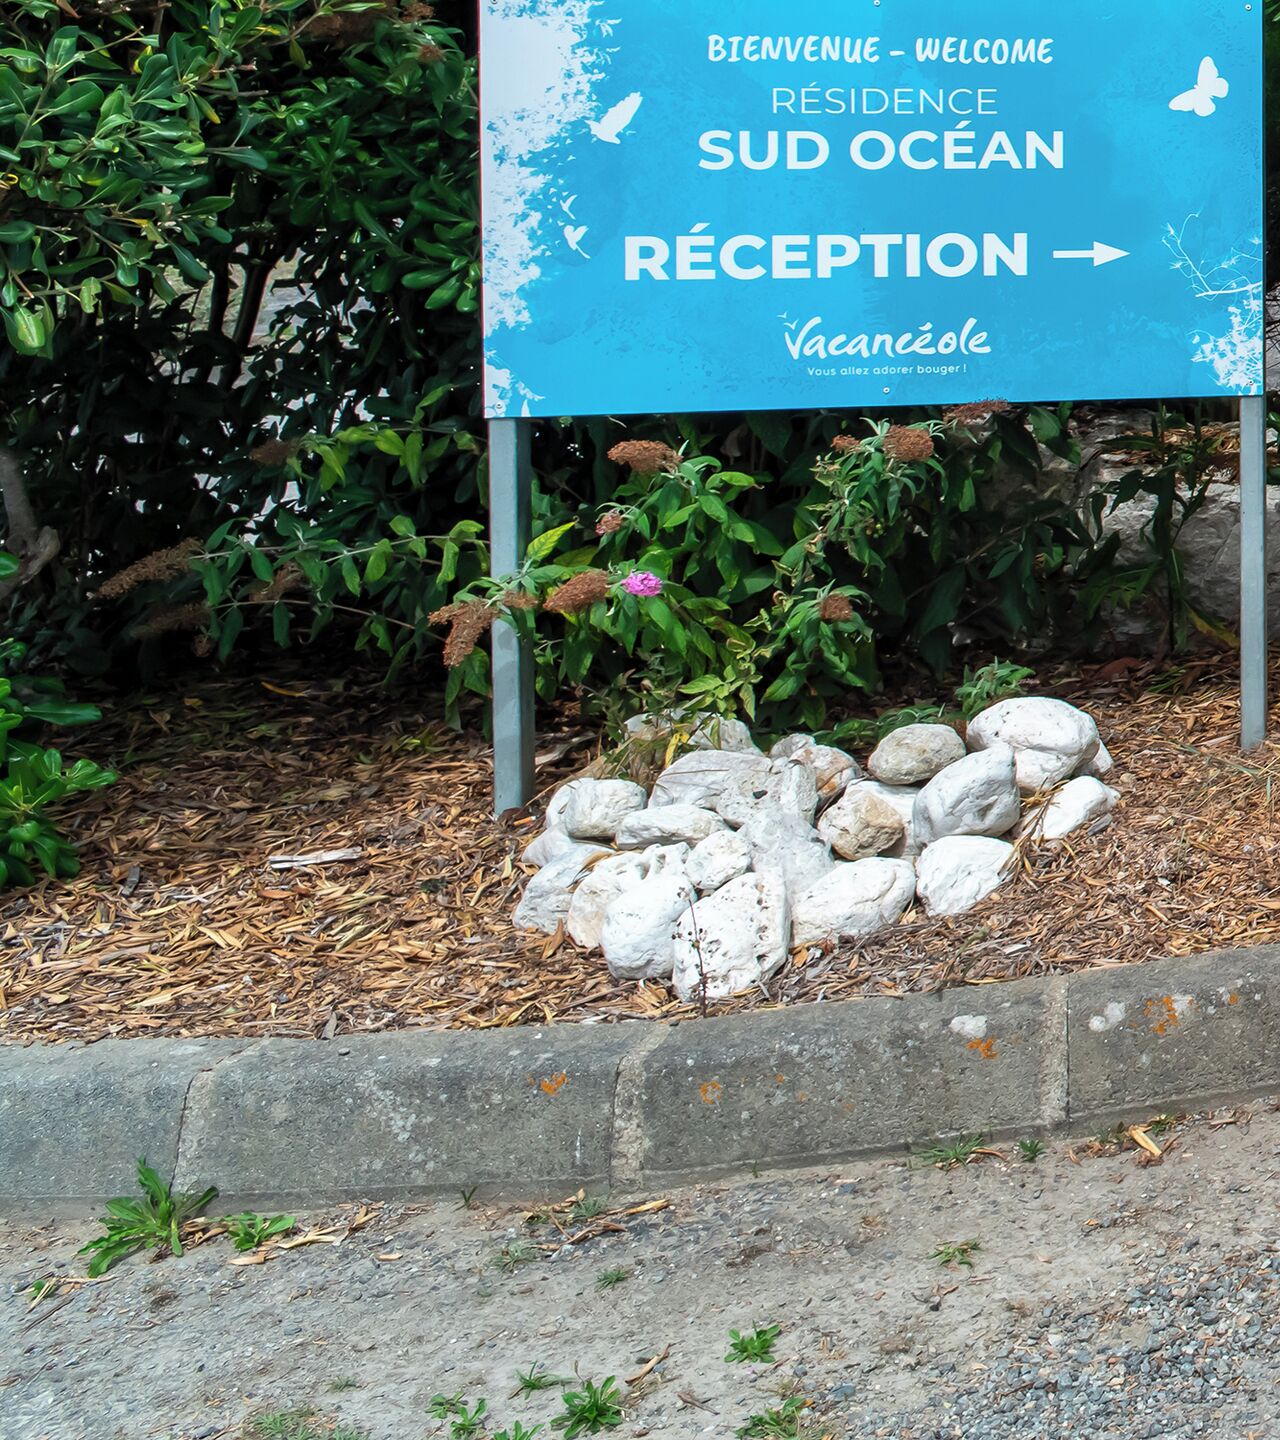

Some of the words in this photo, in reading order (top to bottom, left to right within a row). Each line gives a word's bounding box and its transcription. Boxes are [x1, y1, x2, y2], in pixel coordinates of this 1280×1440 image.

[708, 34, 880, 64] BIENVENUE
[915, 36, 1054, 65] WELCOME
[772, 81, 998, 115] RÉSIDENCE
[698, 129, 830, 171] SUD
[849, 119, 1064, 171] OCÉAN
[624, 222, 1028, 281] RÉCEPTION
[784, 315, 992, 360] Vacancéole
[807, 366, 837, 376] Vous
[840, 365, 869, 376] allez
[872, 364, 914, 376] adorer
[917, 362, 960, 376] bouger
